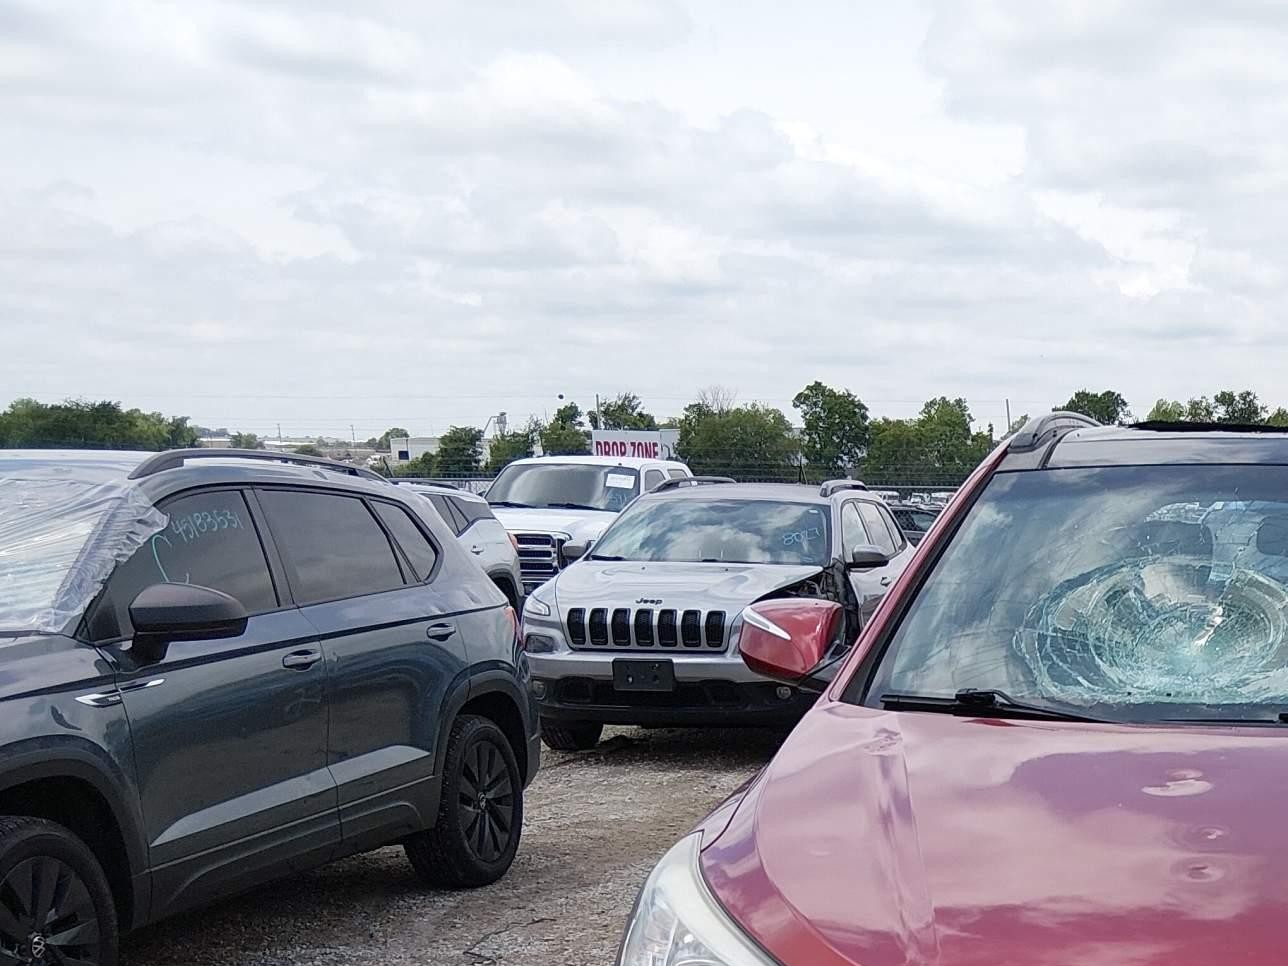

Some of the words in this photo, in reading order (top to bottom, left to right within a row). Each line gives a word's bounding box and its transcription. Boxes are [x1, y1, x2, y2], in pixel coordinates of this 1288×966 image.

[595, 440, 627, 457] DROP
[630, 441, 659, 459] ZONE
[635, 597, 663, 606] Jeep
